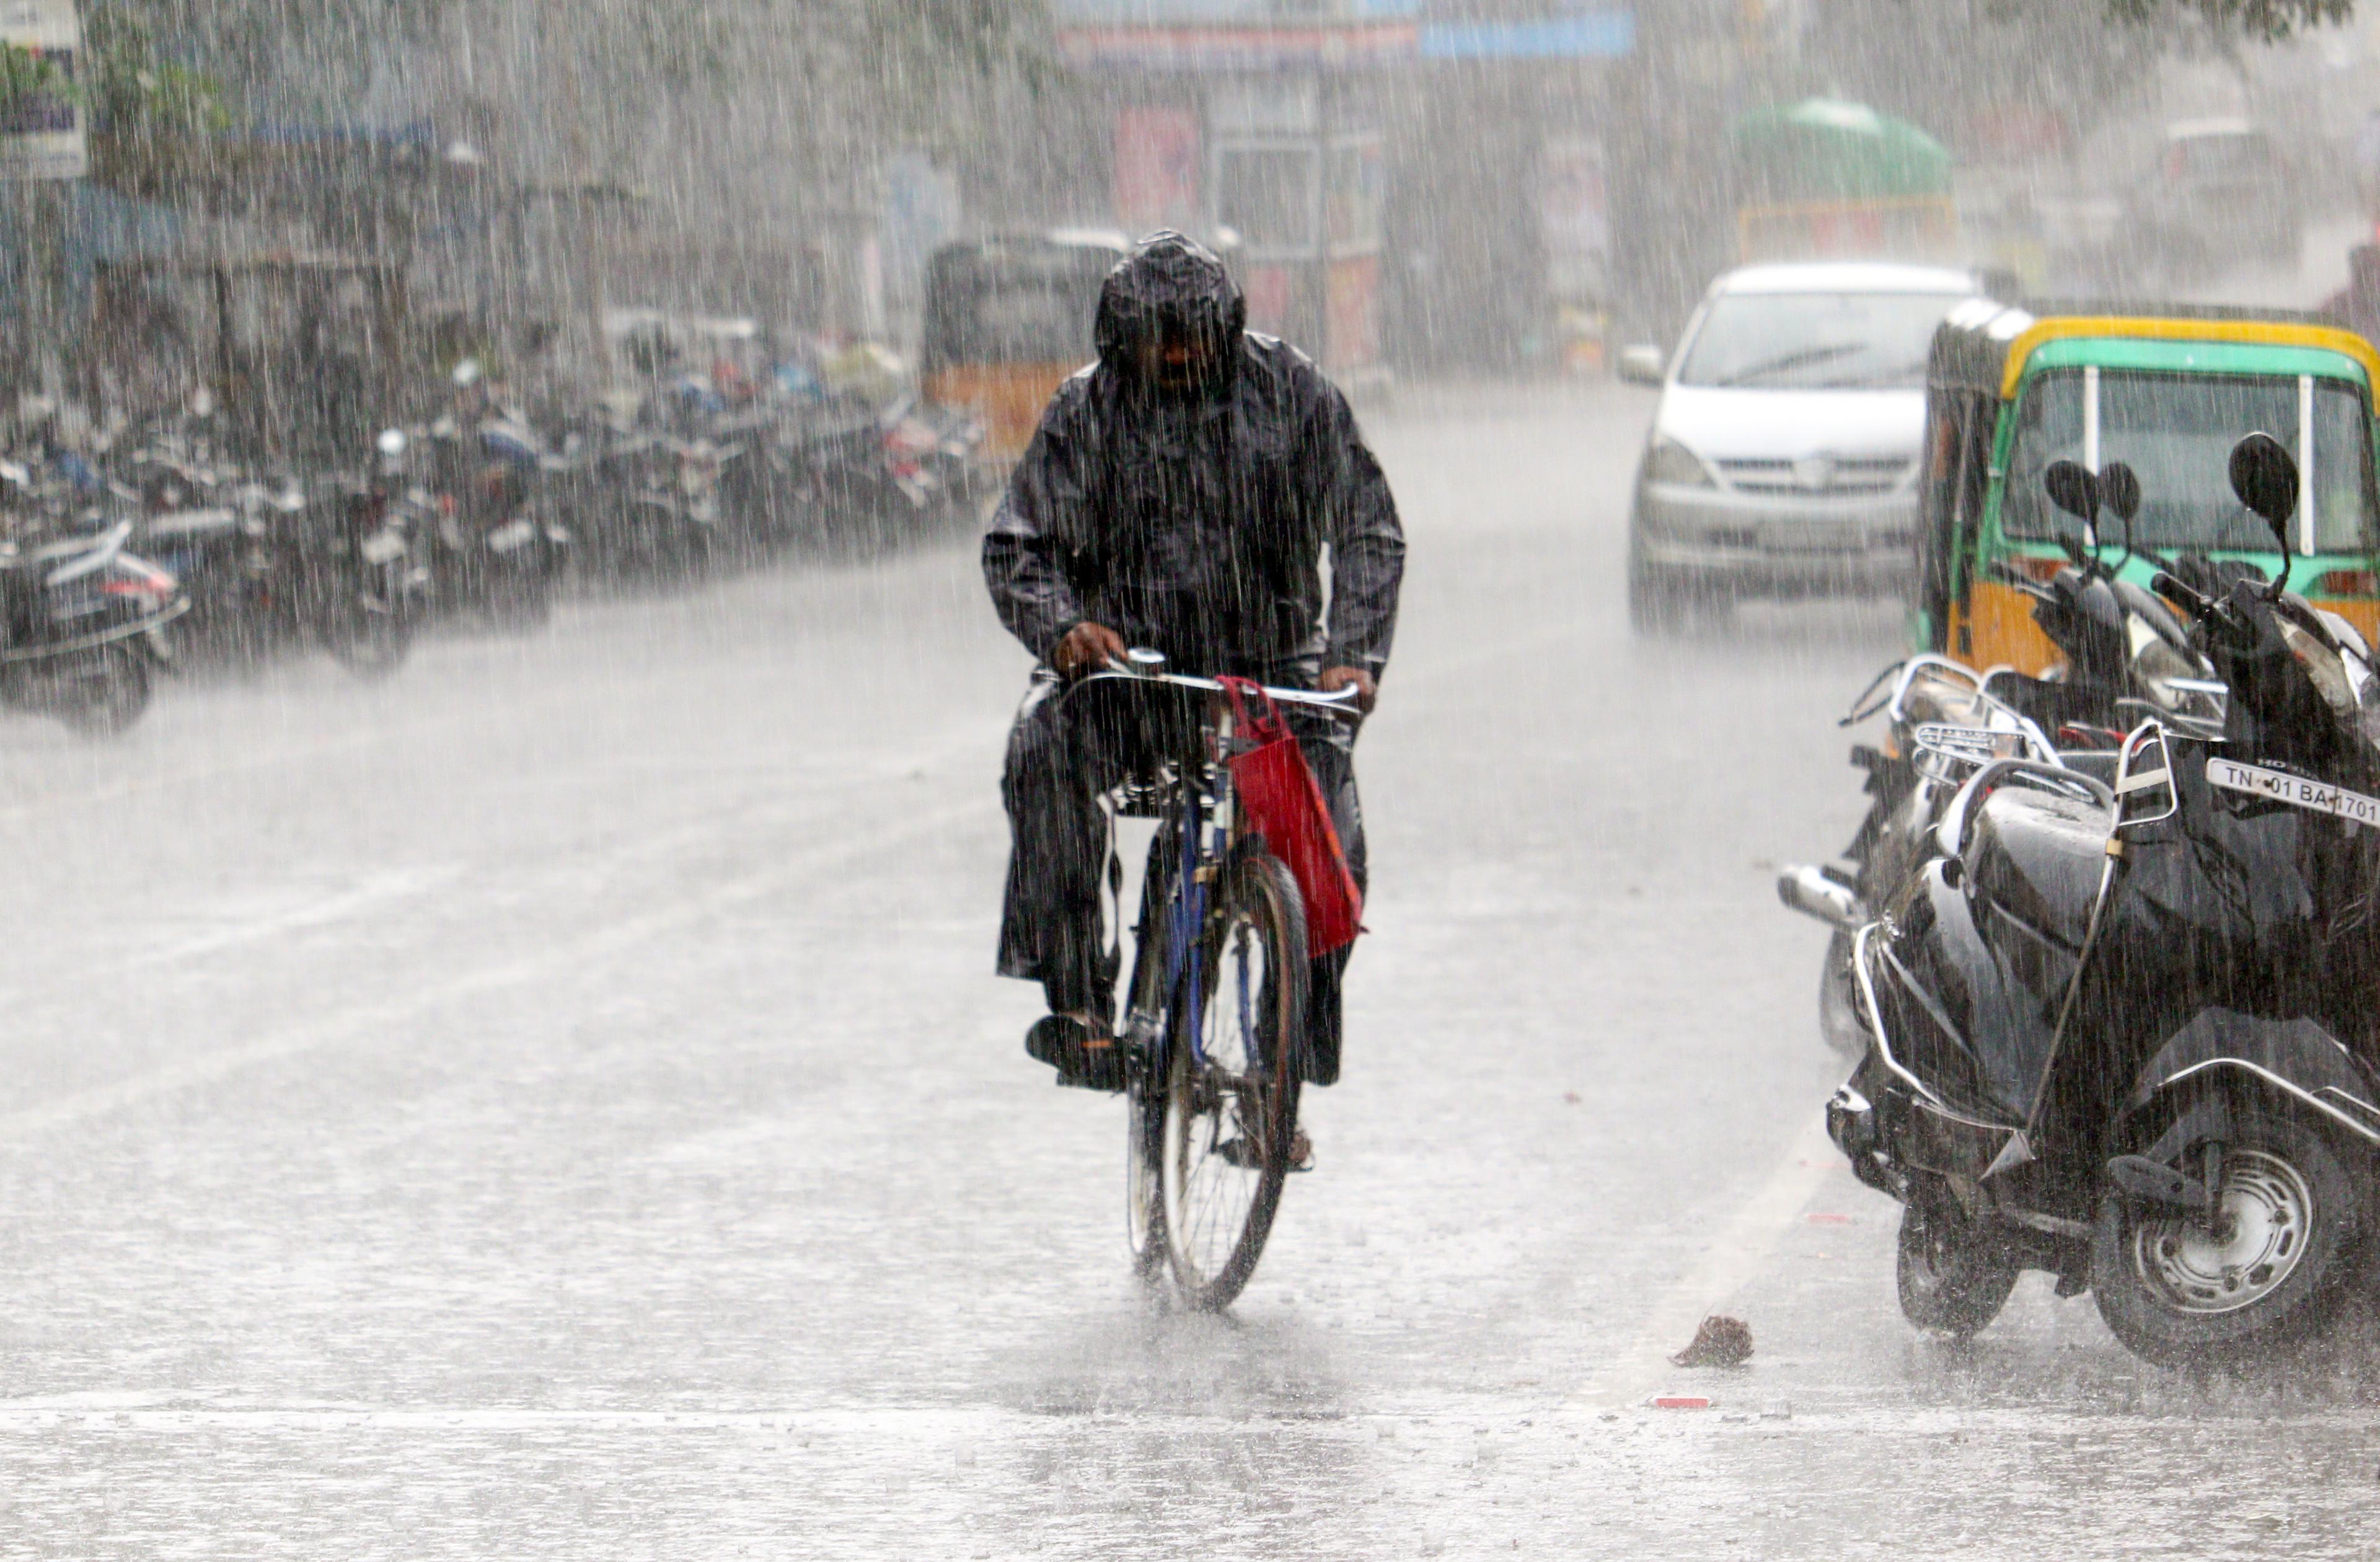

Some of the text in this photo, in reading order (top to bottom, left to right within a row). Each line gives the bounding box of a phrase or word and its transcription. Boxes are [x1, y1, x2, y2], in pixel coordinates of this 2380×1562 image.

[2226, 767, 2252, 788] TN
[2271, 777, 2291, 797] 01
[2301, 785, 2327, 806] BA
[2335, 795, 2375, 821] 1701
